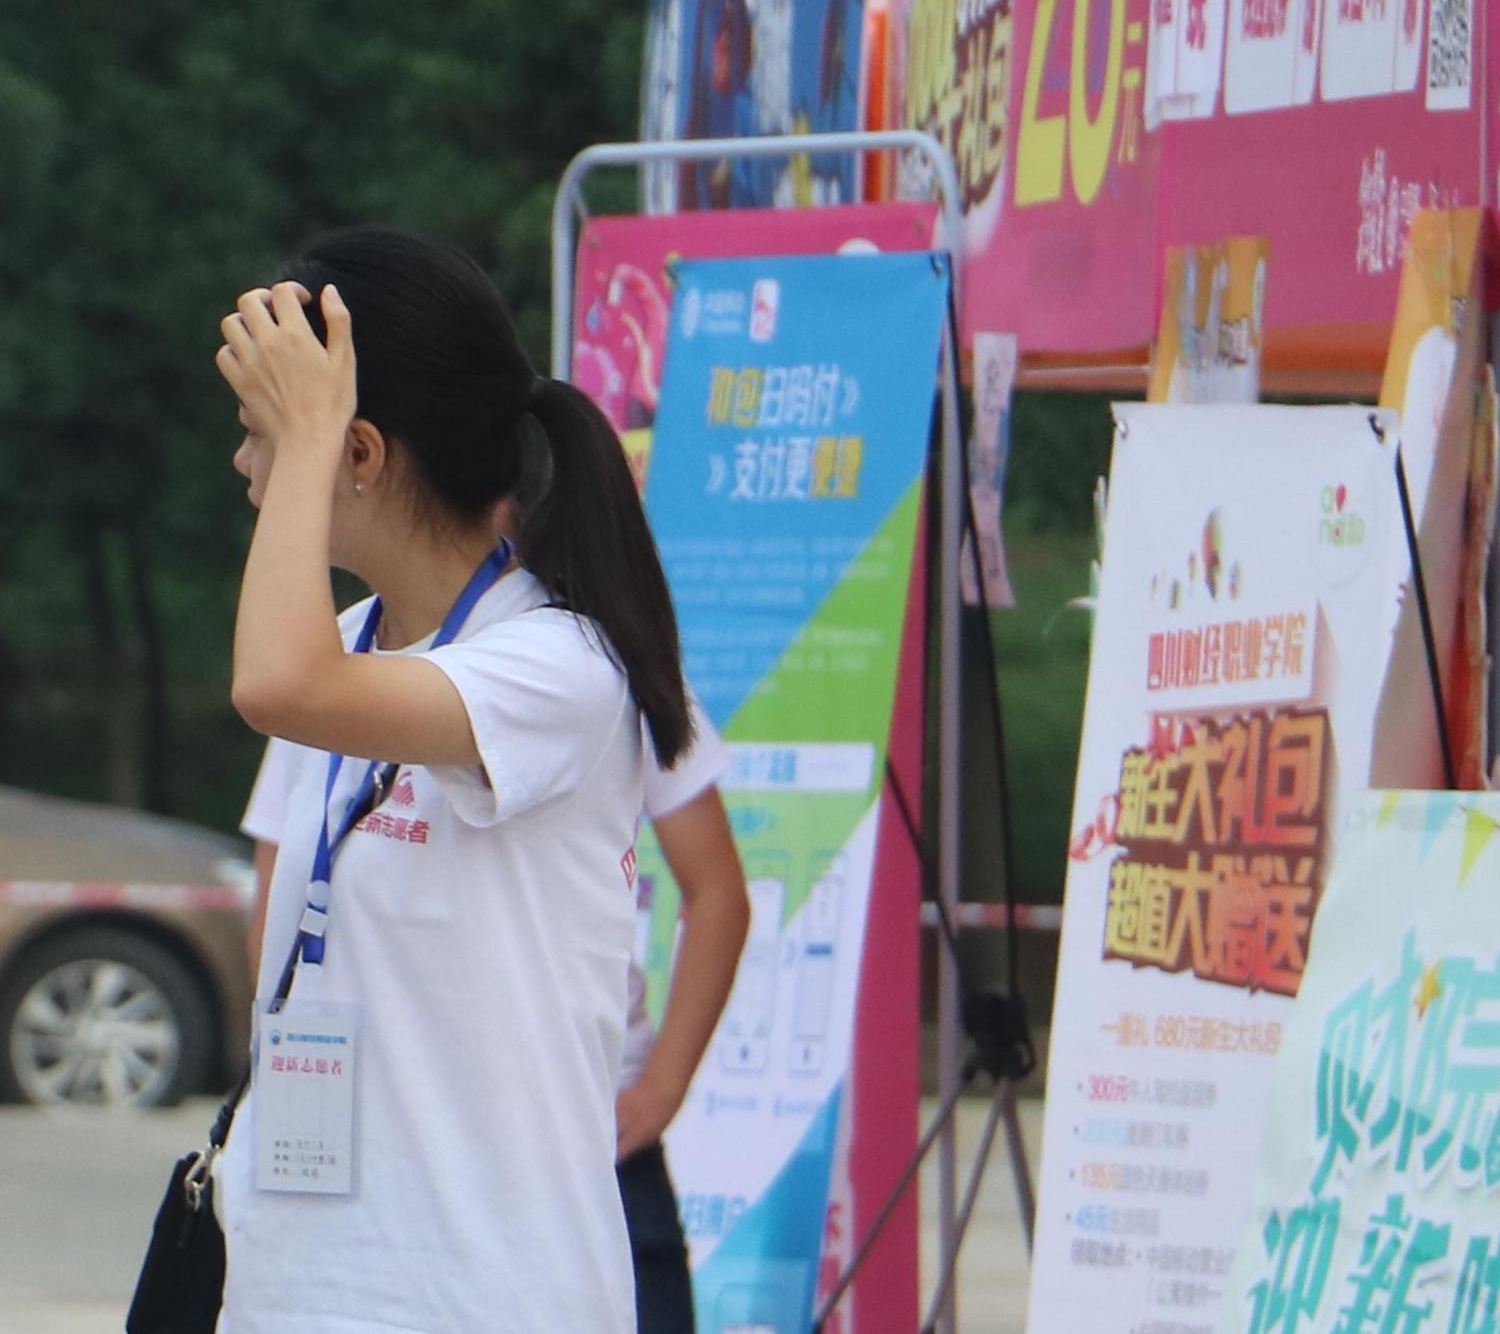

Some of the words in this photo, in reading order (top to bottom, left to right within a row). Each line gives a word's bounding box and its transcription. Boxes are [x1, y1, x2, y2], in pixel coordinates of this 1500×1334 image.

[706, 363, 840, 426] 和包扫码付
[729, 436, 863, 500] 支付更便捷
[1147, 612, 1309, 692] 四川财经职业学院
[1116, 711, 1328, 851] 新生大礼包
[1104, 855, 1316, 997] 超值大赠送
